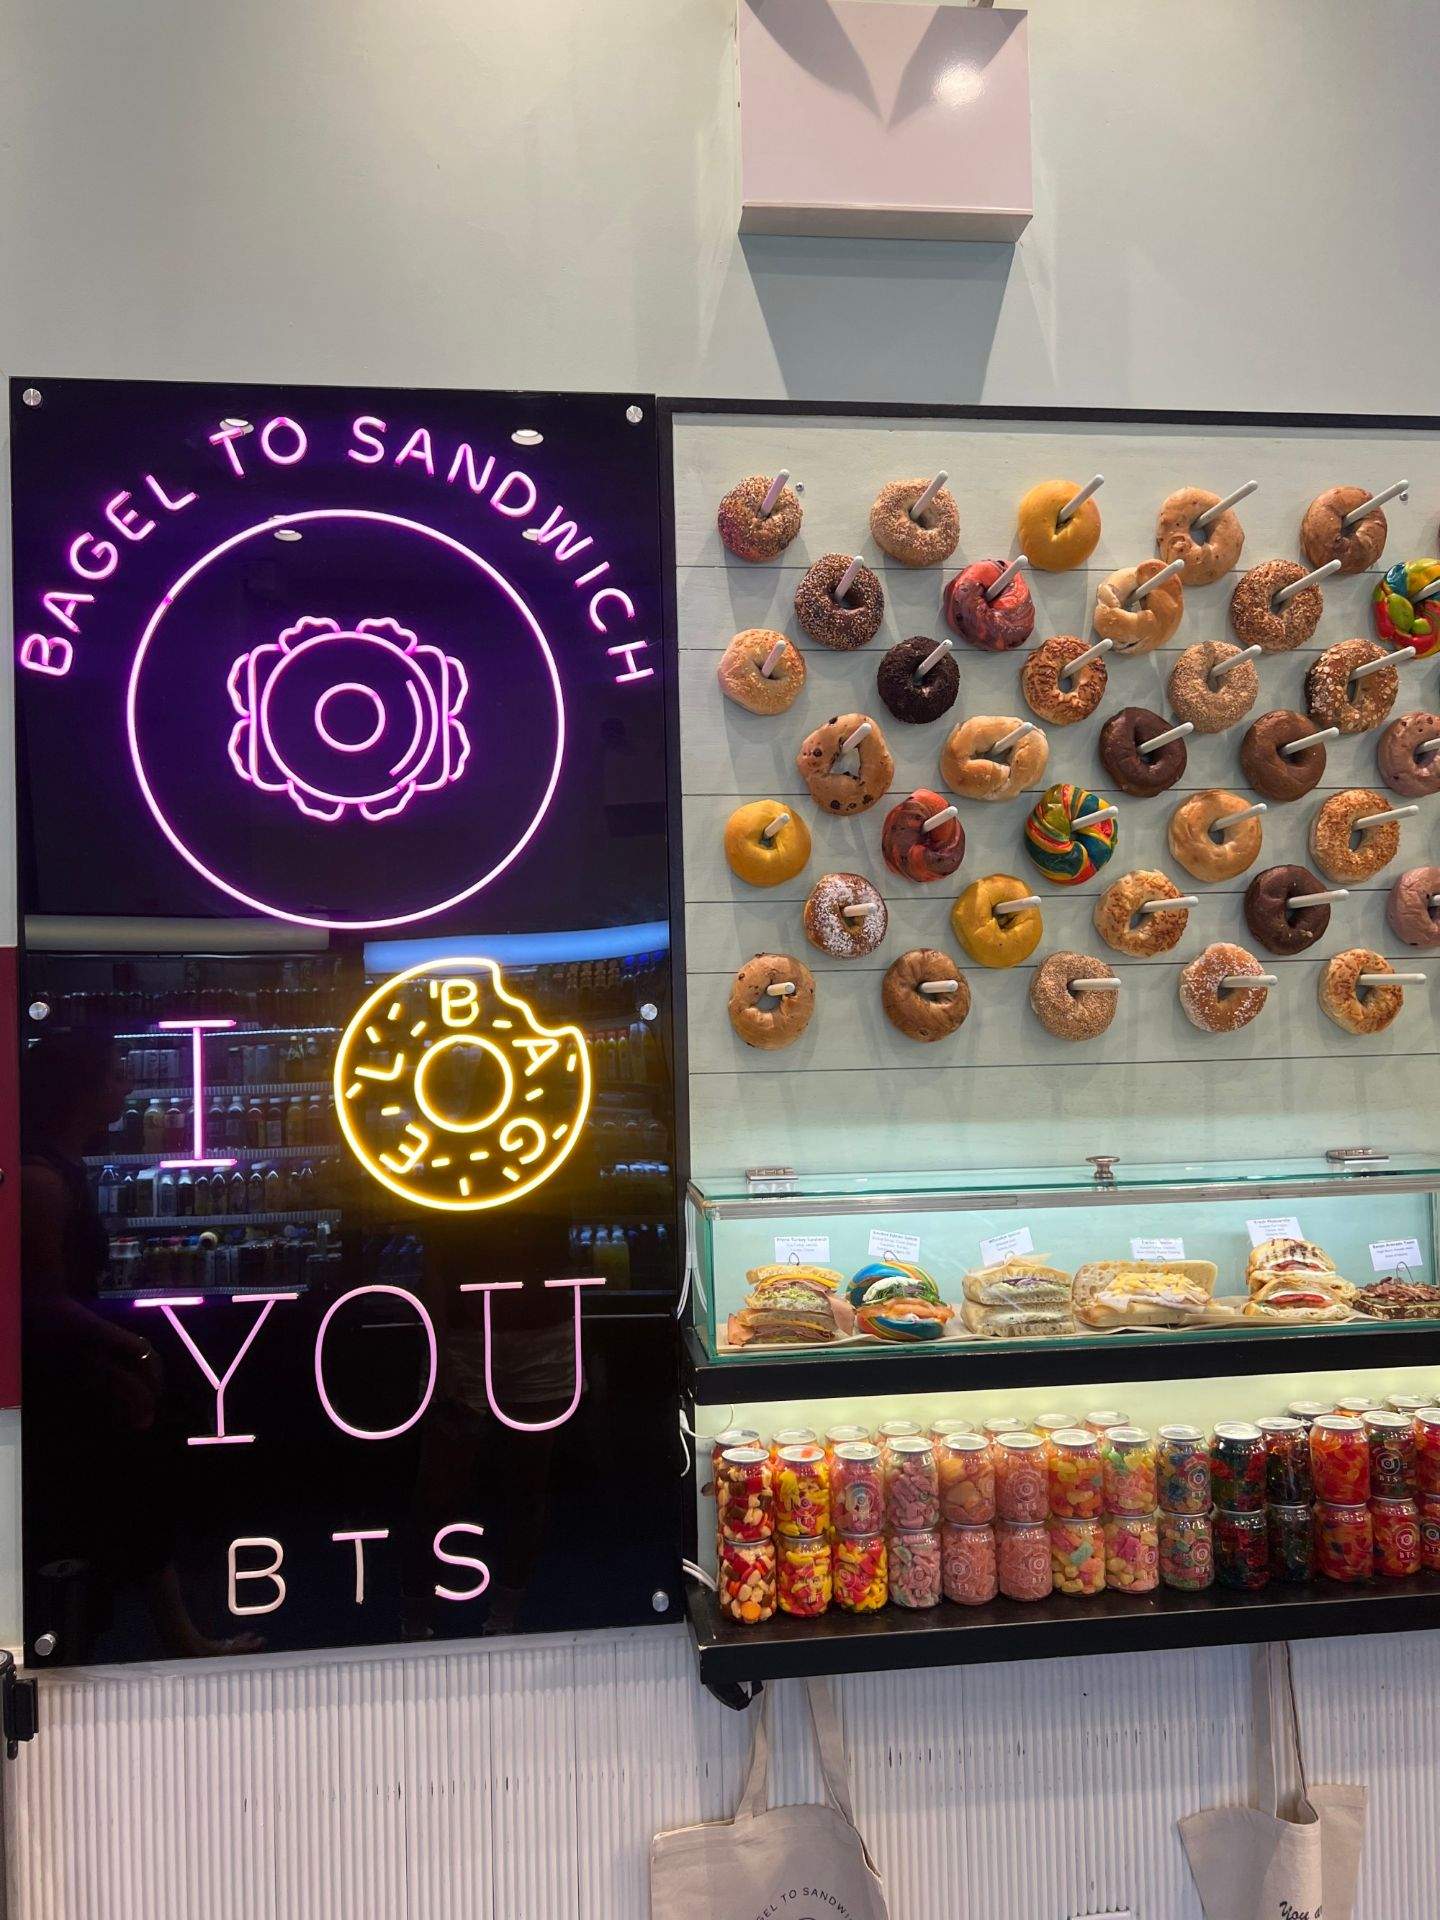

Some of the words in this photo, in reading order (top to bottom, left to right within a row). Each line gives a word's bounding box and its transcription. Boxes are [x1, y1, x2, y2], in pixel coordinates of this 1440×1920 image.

[20, 474, 199, 677] BAGEL
[208, 416, 308, 478] TO
[348, 415, 655, 684] SANDWICH
[158, 1019, 238, 1168] I
[354, 978, 561, 1175] BAGEL
[133, 1277, 607, 1446] YOU
[227, 1522, 492, 1617] BTS
[780, 1889, 797, 1902] TO
